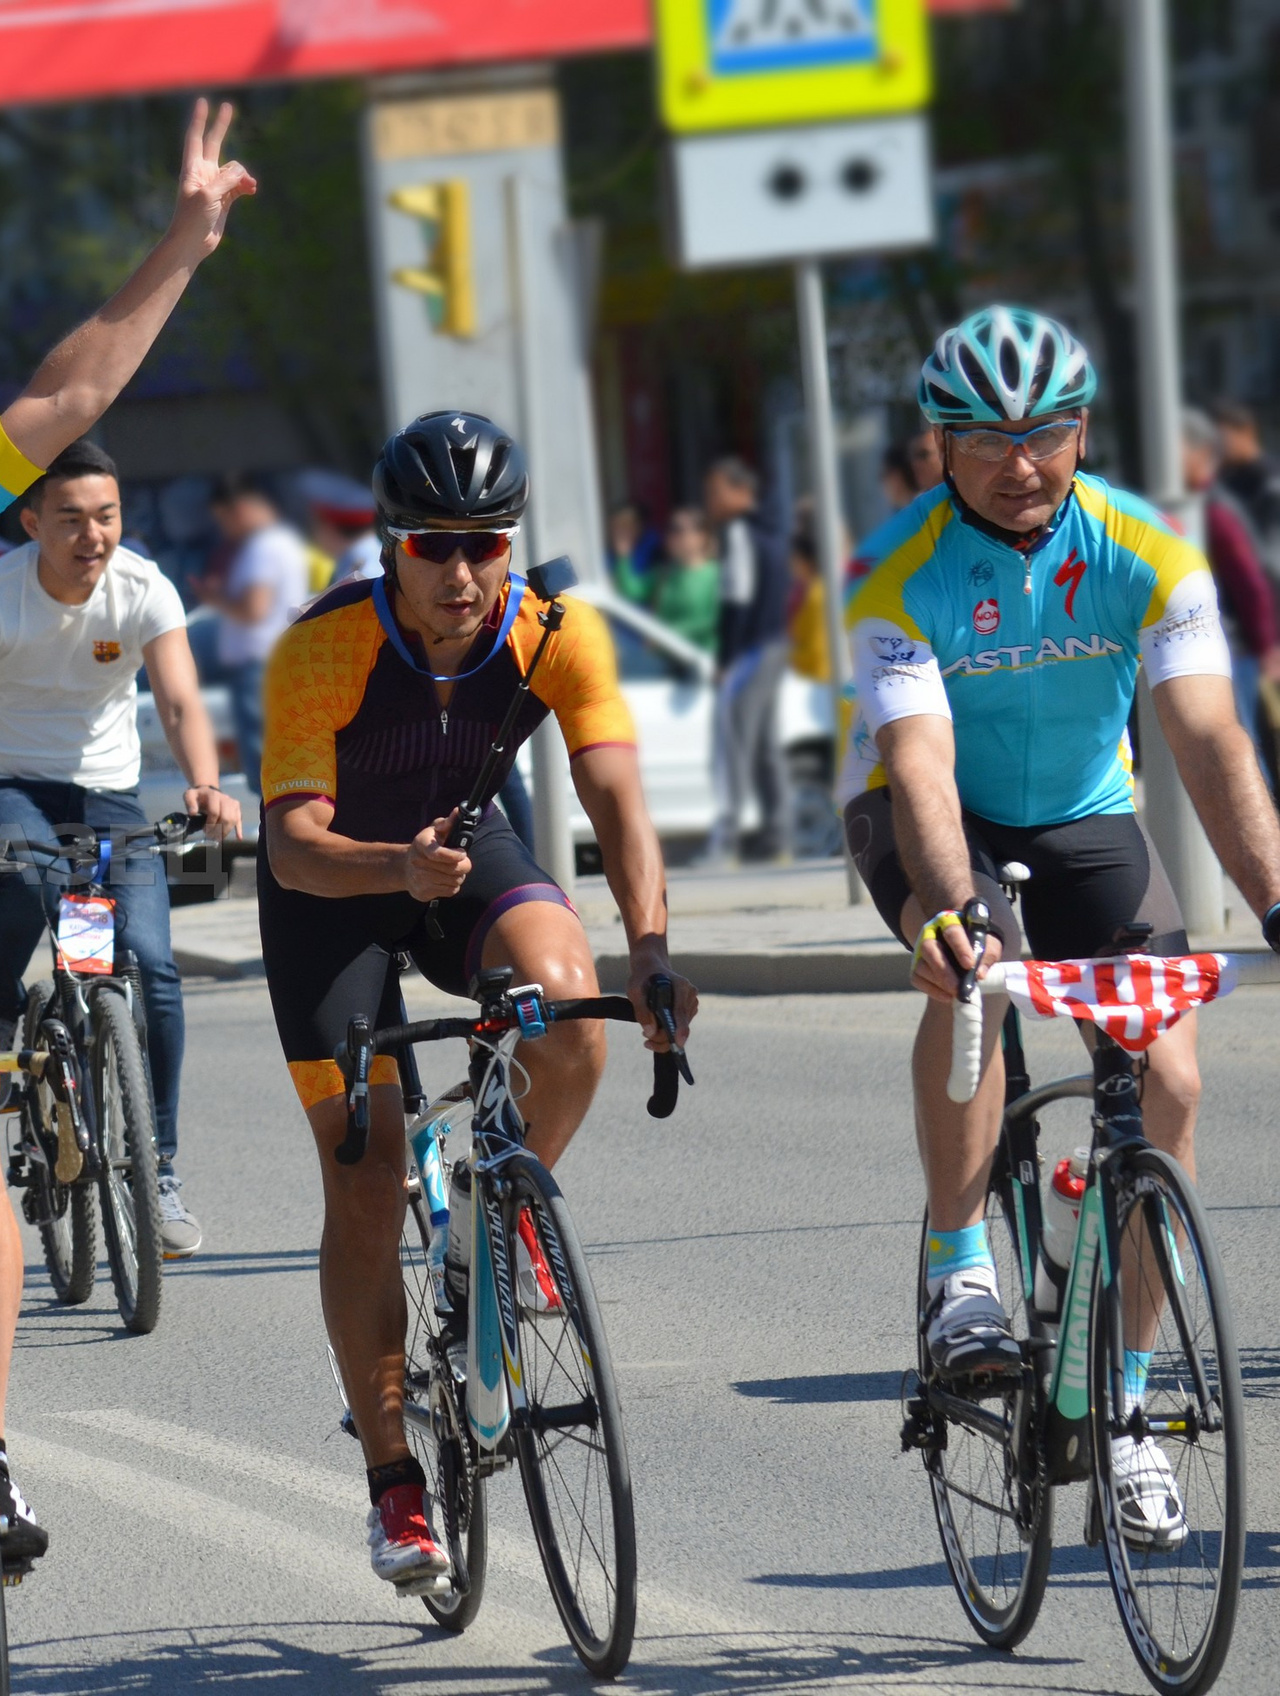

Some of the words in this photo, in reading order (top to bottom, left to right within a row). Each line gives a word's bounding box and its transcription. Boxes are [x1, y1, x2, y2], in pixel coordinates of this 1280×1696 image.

[942, 634, 1123, 675] ASTANA
[275, 783, 287, 791] LA
[288, 780, 328, 789] VUELTA
[485, 1197, 515, 1330] SPECIALIZED
[1063, 1211, 1100, 1389] Bianchi
